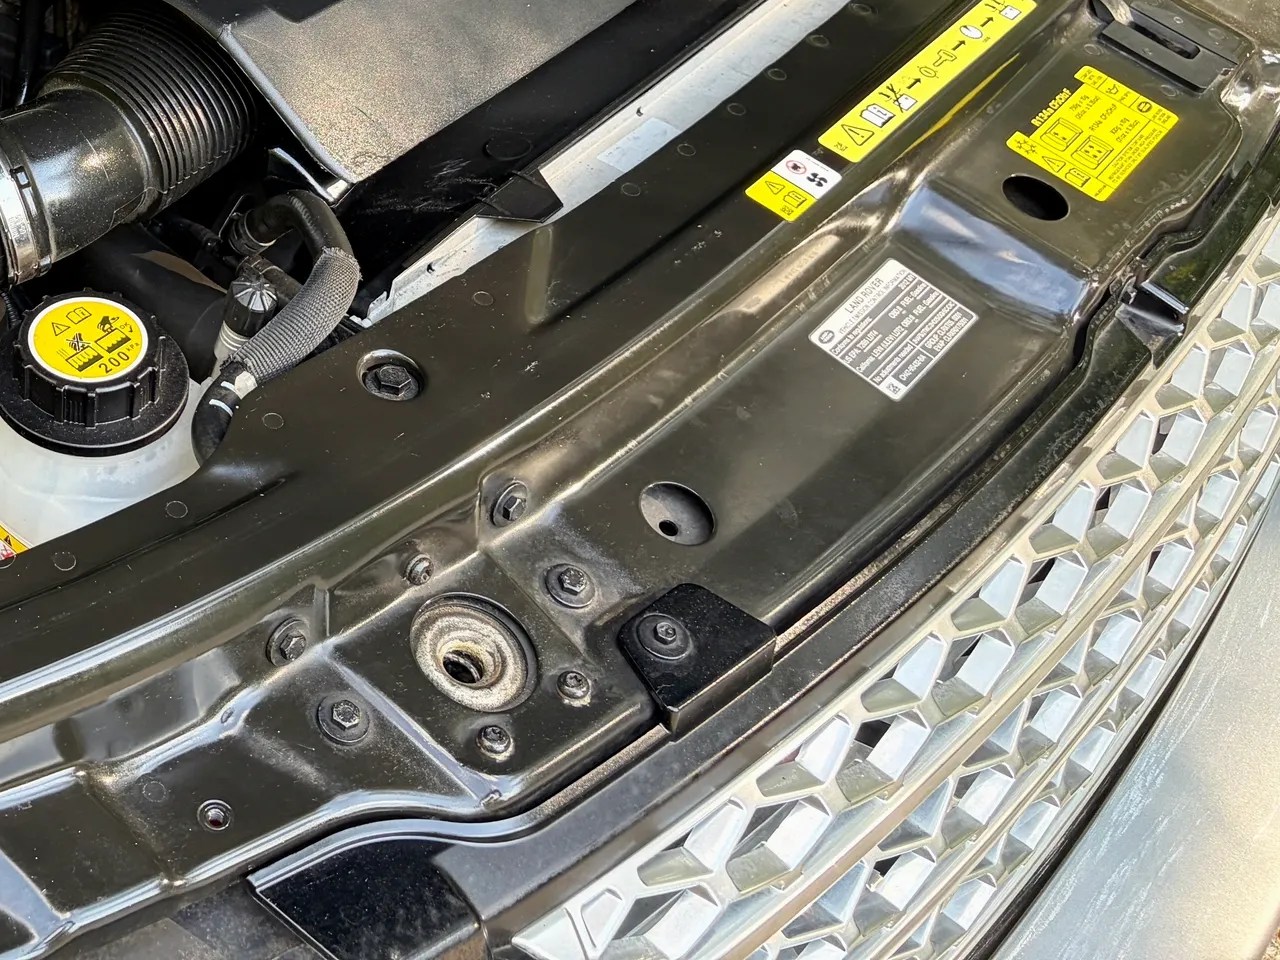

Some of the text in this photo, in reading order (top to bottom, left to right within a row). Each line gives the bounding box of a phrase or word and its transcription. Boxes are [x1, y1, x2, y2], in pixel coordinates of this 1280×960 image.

[843, 276, 884, 313] LAND ROVER
[126, 342, 140, 352] kPa
[98, 351, 130, 374] 200
